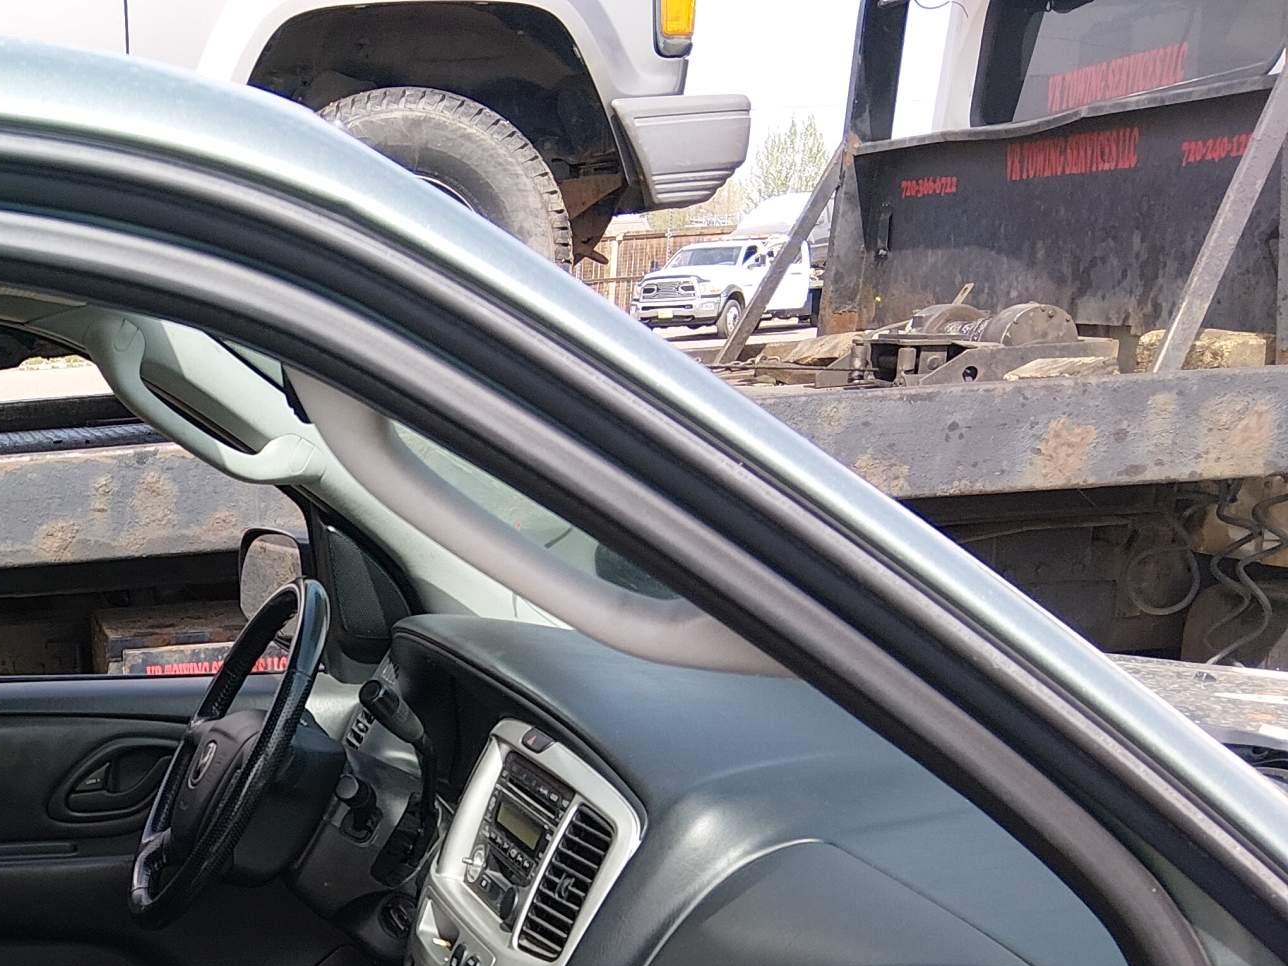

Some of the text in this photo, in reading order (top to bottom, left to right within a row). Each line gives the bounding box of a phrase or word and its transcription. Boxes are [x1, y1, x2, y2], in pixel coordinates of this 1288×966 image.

[1163, 41, 1188, 84] LLC
[1022, 137, 1064, 179] TOWING
[1065, 131, 1117, 175] SERVICES
[1117, 127, 1139, 169] LLC
